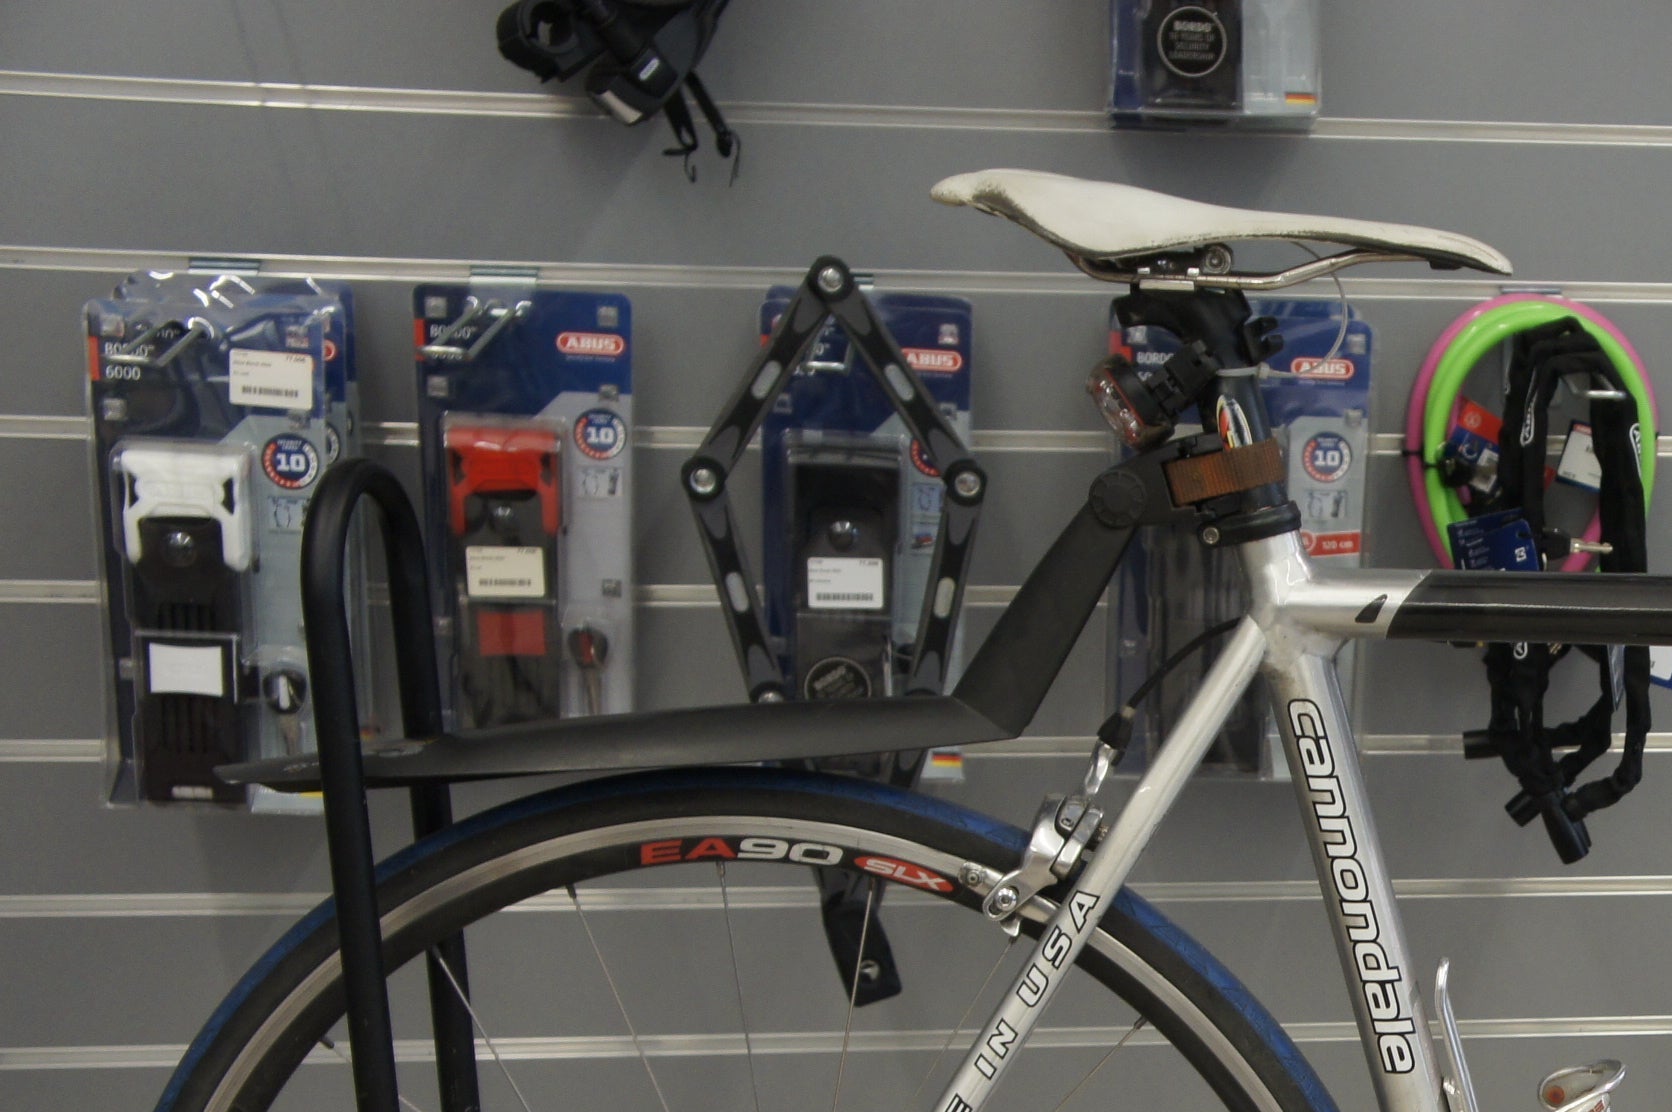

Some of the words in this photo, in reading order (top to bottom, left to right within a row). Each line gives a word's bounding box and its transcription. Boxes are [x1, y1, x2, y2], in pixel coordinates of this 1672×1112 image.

[566, 336, 615, 349] ABUS
[906, 352, 954, 367] ABUS
[105, 366, 141, 381] 6000
[587, 426, 614, 444] 10
[276, 452, 306, 472] 10
[1314, 450, 1340, 466] 10
[640, 836, 843, 865] EA90
[862, 858, 946, 891] SLX
[1288, 698, 1415, 1075] cannondale
[975, 1018, 1018, 1080] IN
[1016, 890, 1100, 1009] USA
